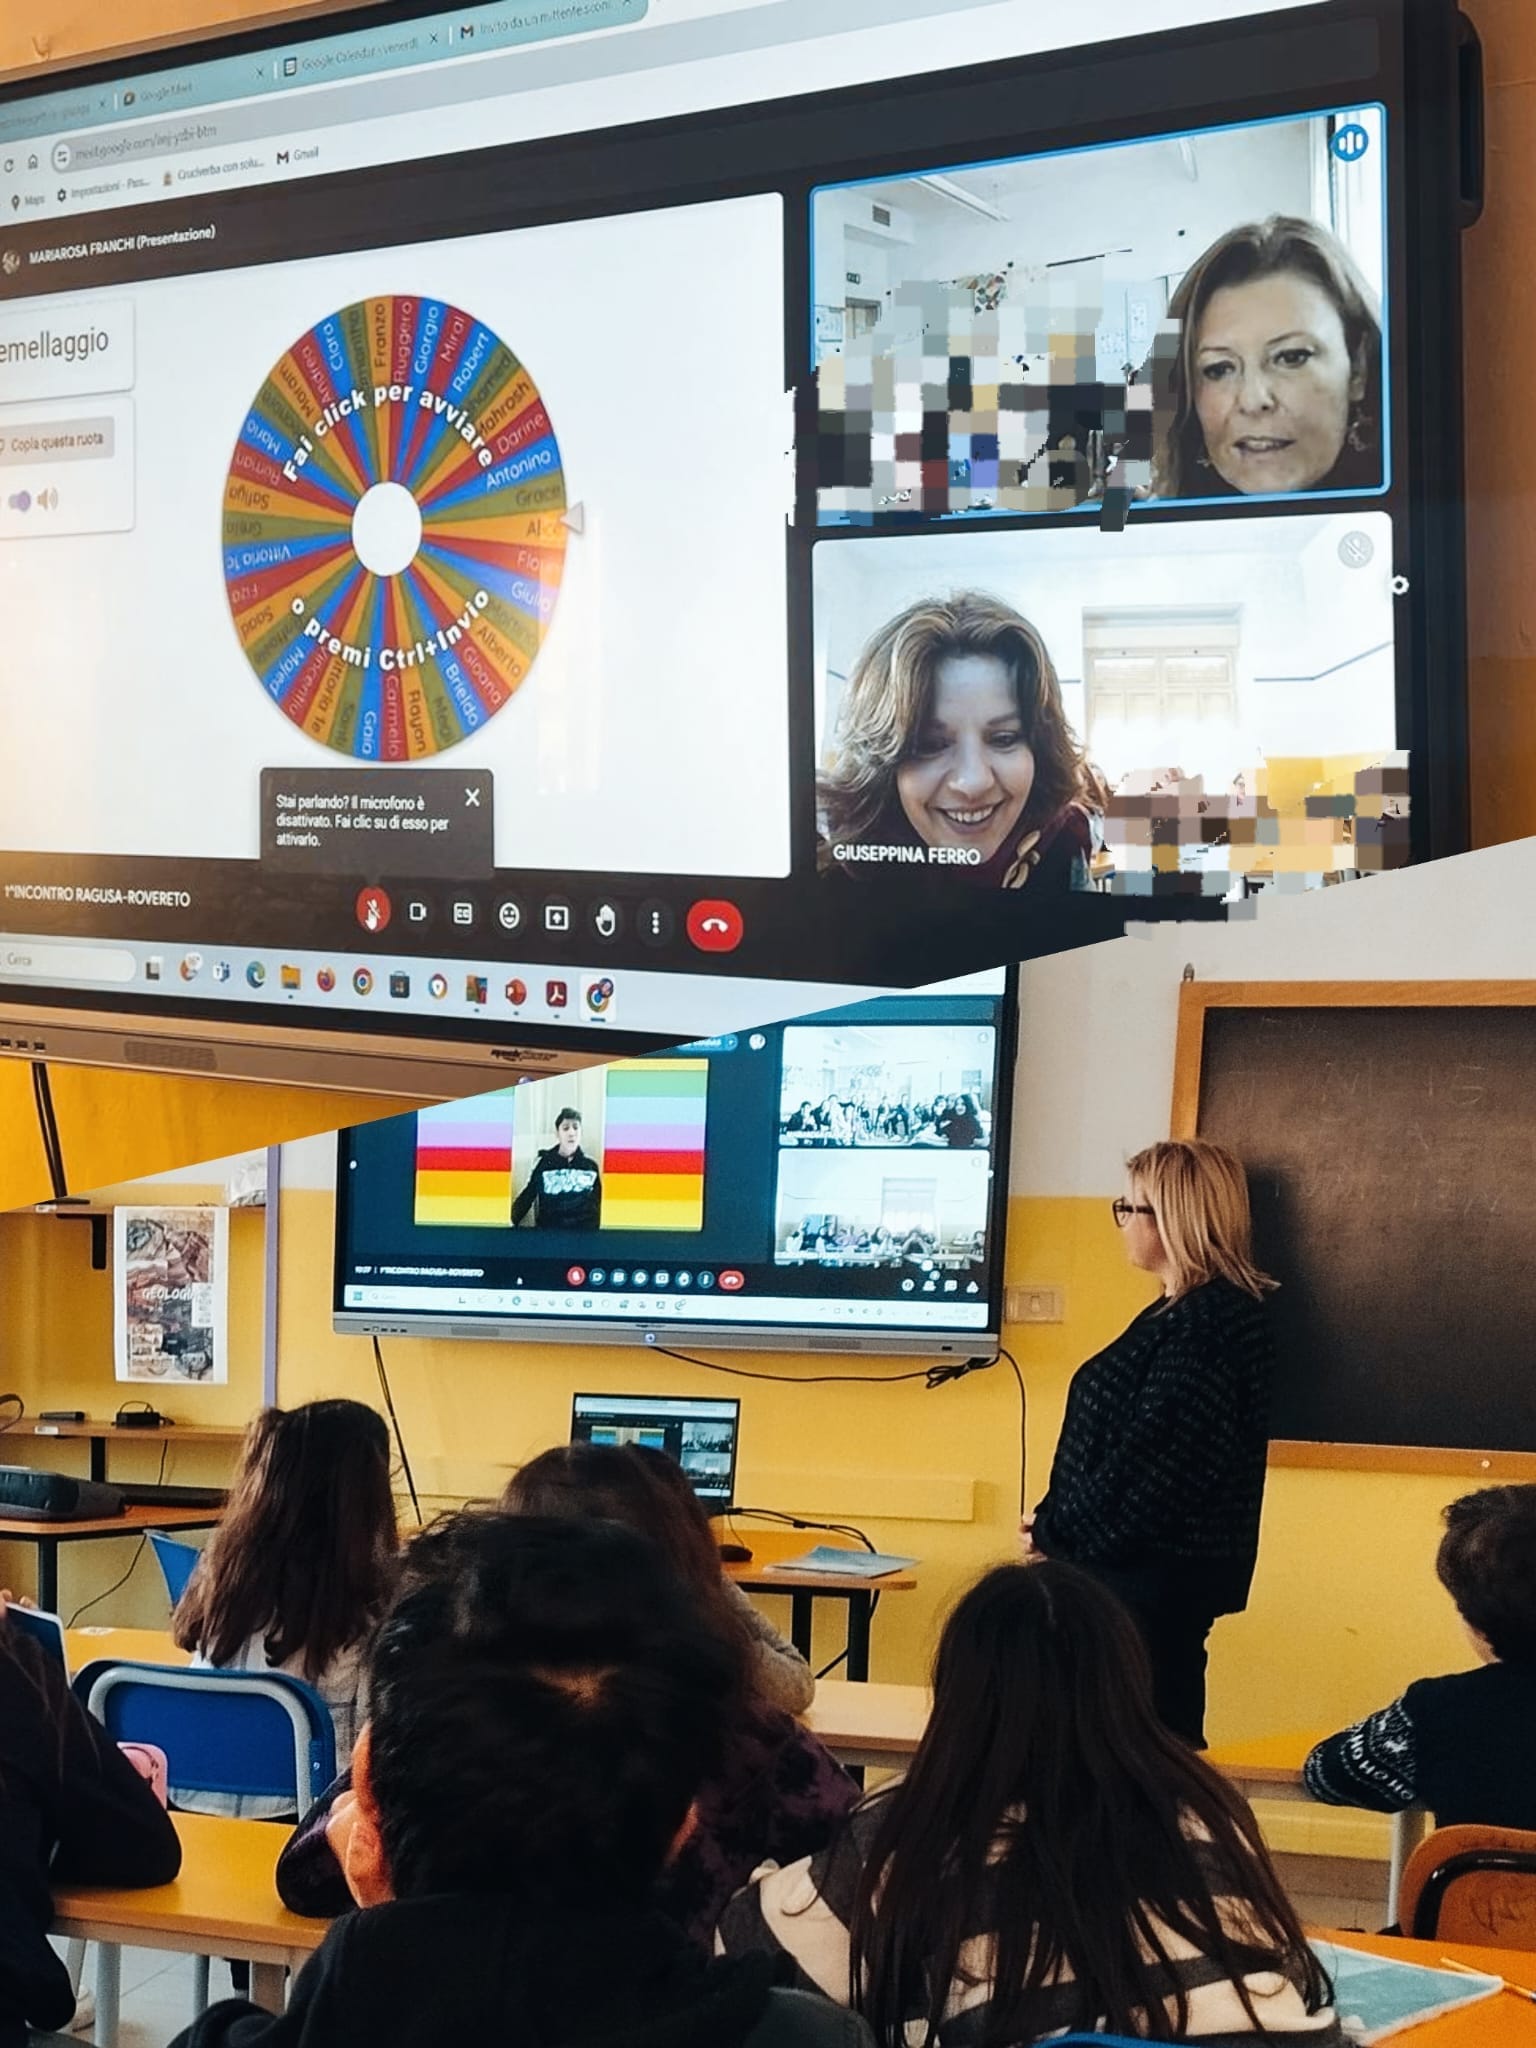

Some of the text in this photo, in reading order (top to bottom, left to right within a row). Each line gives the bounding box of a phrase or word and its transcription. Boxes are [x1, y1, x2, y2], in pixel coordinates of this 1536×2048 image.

[177, 163, 221, 180] Cruciverba
[294, 146, 319, 161] Gmail
[24, 195, 45, 207] Maps
[29, 223, 216, 264] MARIAROSA FRANCHI (Presentazione)
[0, 326, 109, 363] emellaggio
[323, 323, 344, 372] Clara
[393, 301, 414, 383] Ruggero
[413, 306, 439, 375] Giorgio
[301, 345, 335, 404] Andrea
[452, 332, 489, 392] Robert
[11, 432, 104, 454] Copia questa ruota
[283, 384, 493, 483] Fai click per avviare
[496, 413, 545, 454] Darine
[486, 449, 551, 492] Antonino
[243, 544, 292, 565] Vittoria
[240, 606, 274, 640] Saad
[291, 590, 490, 671] o premi Ctrl+Invio
[268, 647, 306, 697] Majed
[478, 627, 522, 678] Alberto
[318, 659, 346, 711] ittoria
[446, 663, 479, 727] Brieldo
[386, 674, 400, 758] Carmelo
[276, 794, 297, 809] Stai
[298, 794, 349, 812] parlando?
[360, 796, 415, 811] microfono
[276, 812, 449, 833] disattivato. Fai clic su di esso per
[276, 831, 321, 847] attivarlo.
[833, 844, 981, 865] GIUSEPPINA FERRO
[75, 886, 191, 908] RAGUSA-ROVERETO
[142, 1287, 196, 1301] GEOLOGI
